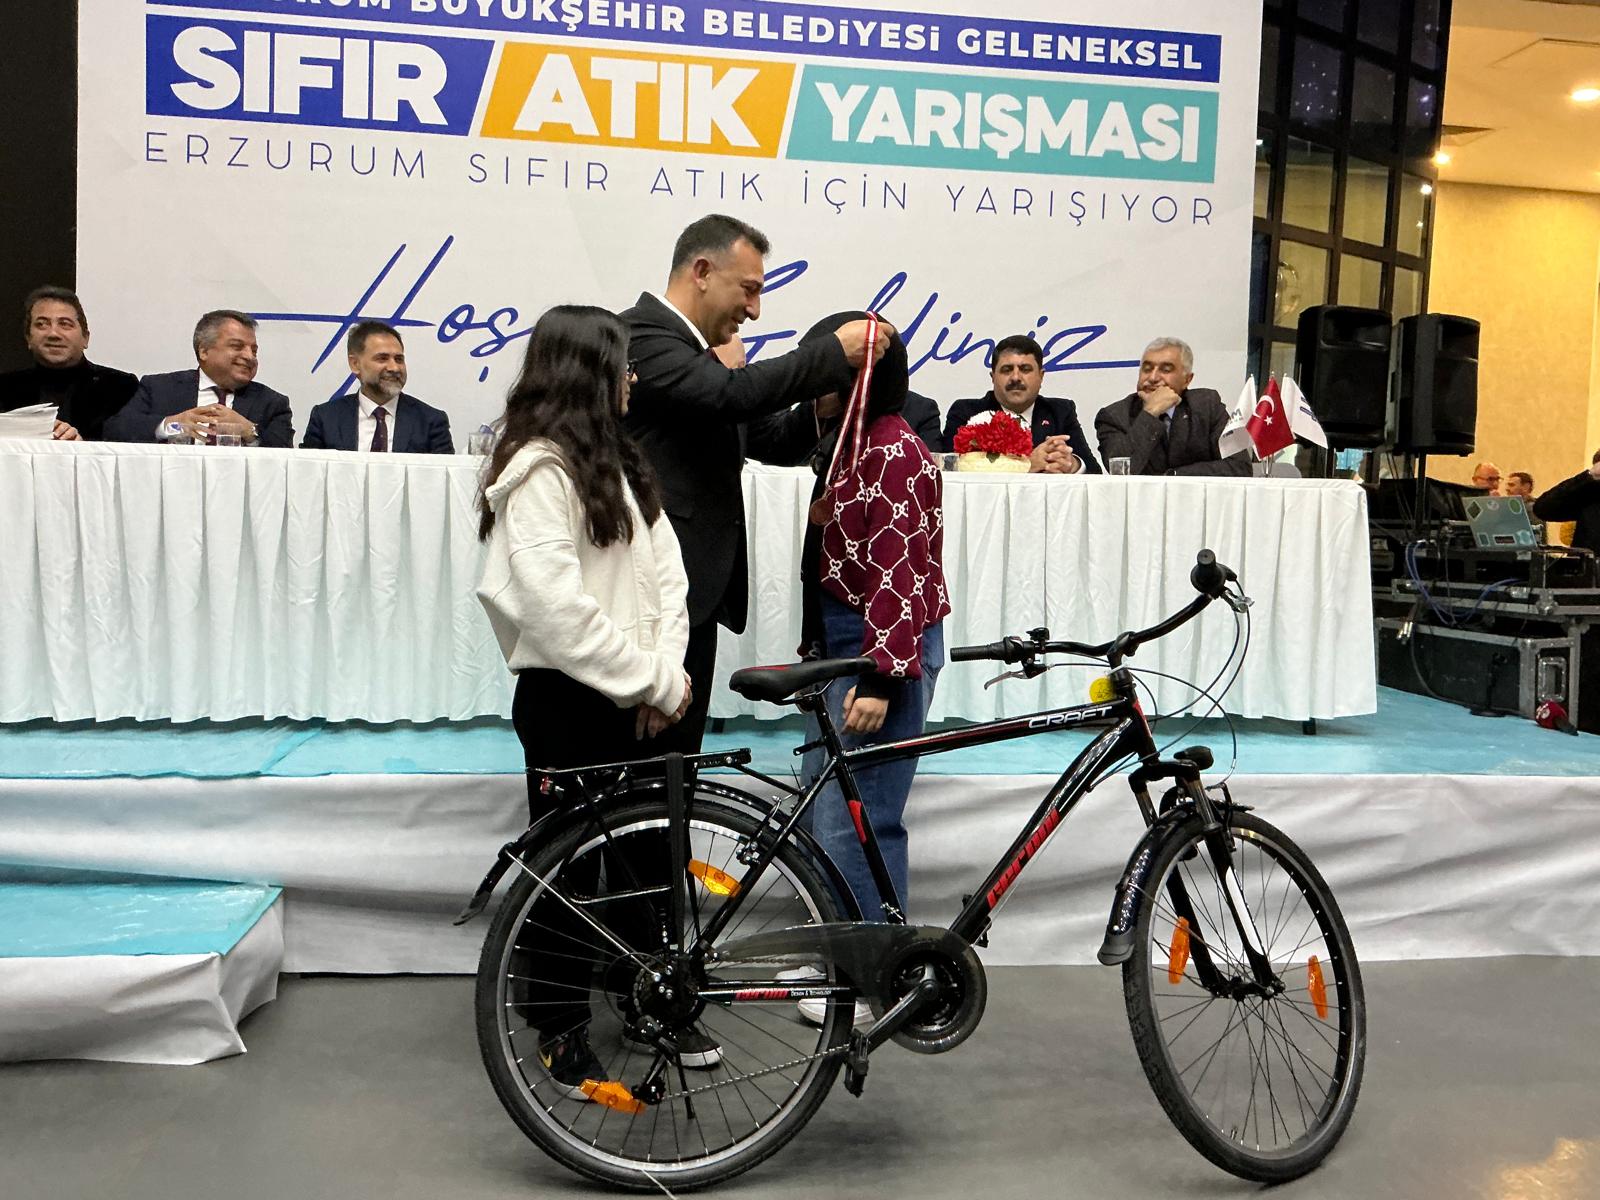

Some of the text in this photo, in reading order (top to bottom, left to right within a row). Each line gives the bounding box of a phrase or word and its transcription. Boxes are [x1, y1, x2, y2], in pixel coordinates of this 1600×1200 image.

[957, 28, 1202, 70] GELENEKSEL
[170, 25, 1200, 163] SIFIR ATIK YARIŞMASI
[145, 131, 426, 179] ERZURUM
[467, 153, 609, 192] SIFIR
[649, 166, 763, 202] ATIK
[946, 184, 1213, 227] YARIŞIYOR
[1028, 705, 1113, 729] CRAFT
